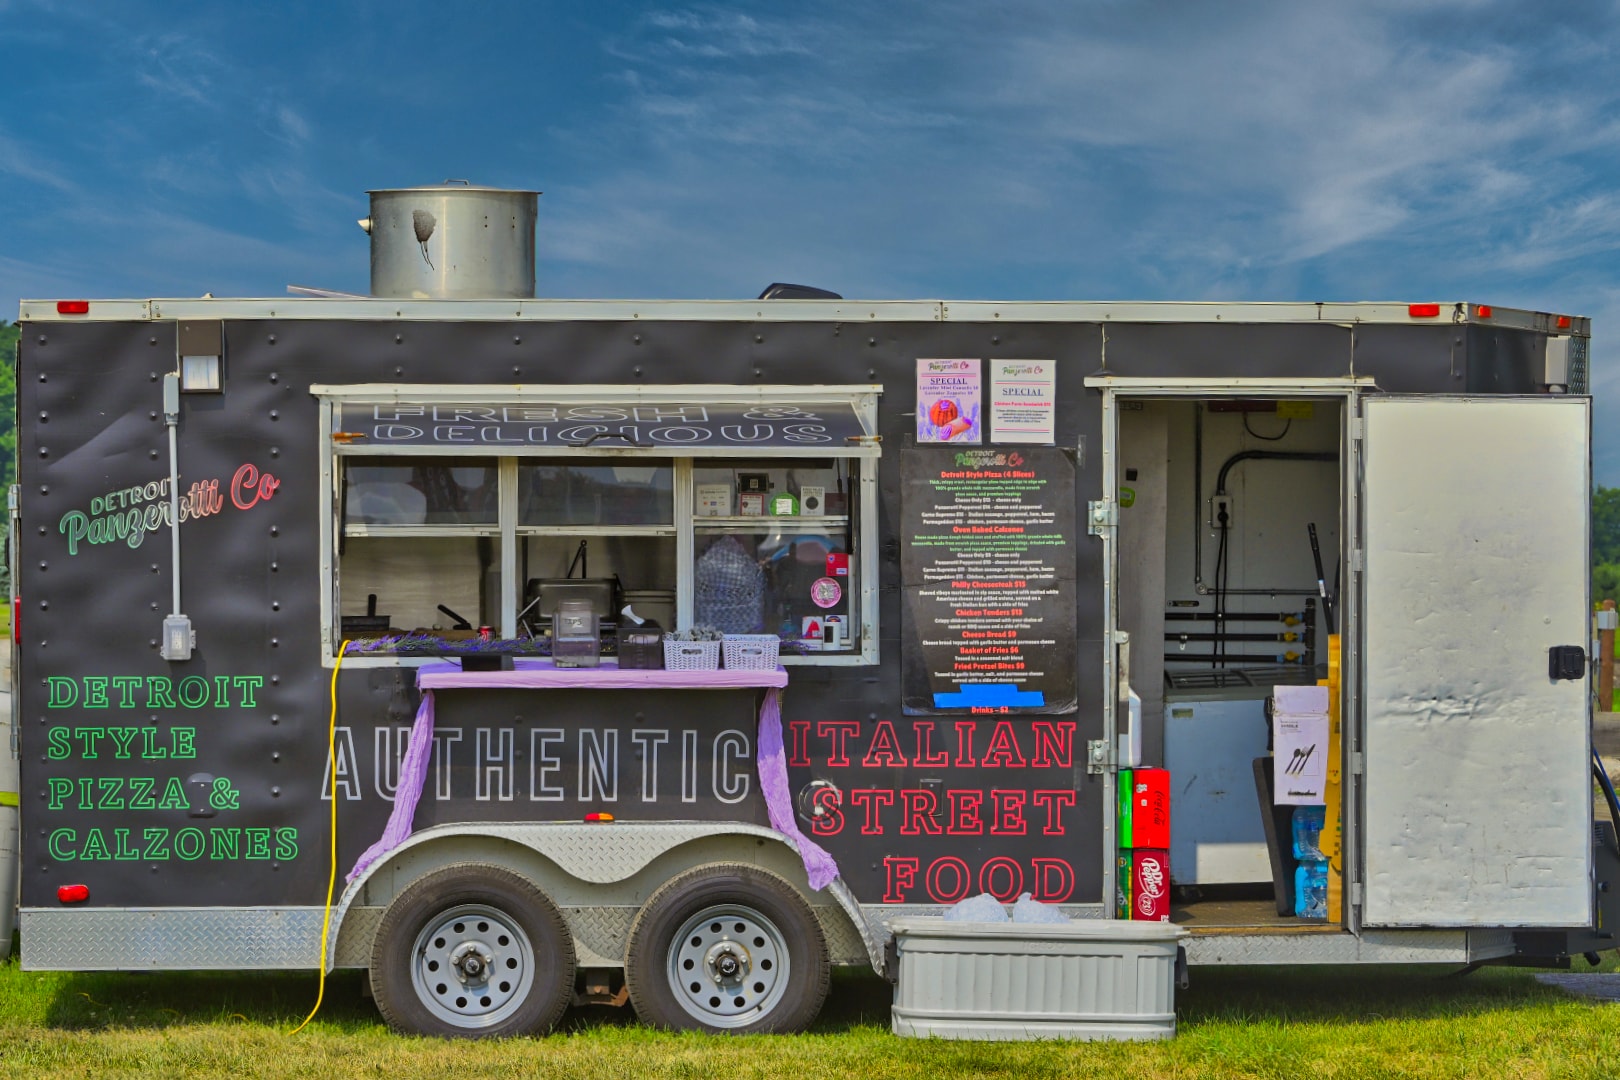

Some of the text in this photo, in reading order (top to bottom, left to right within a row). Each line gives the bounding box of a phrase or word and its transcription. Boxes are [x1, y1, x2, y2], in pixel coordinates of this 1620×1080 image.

[960, 361, 969, 372] Co
[1034, 366, 1043, 376] Co
[1002, 388, 1044, 396] SPECIAL
[374, 404, 824, 423] FRESH &
[374, 424, 832, 443] DELICIOUS
[1008, 452, 1025, 467] Co
[941, 471, 964, 479] Detroit
[965, 471, 982, 479] Style
[984, 471, 1002, 479] Pizza
[1012, 471, 1034, 479] Slices)
[231, 464, 280, 509] Co
[960, 646, 983, 654] Basket
[992, 646, 1009, 654] Fries
[1009, 646, 1019, 654] $6
[954, 662, 972, 670] Fried
[973, 662, 997, 670] Pretzel
[998, 662, 1015, 670] Bites
[48, 675, 263, 708] DETROIT
[971, 706, 994, 714] Drinks
[1000, 706, 1009, 714] $2
[48, 726, 196, 760] STYLE
[789, 721, 1076, 768] ITALIAN
[320, 726, 750, 804] AUTHENTIC
[48, 777, 240, 810] PIZZA &
[812, 787, 1076, 836] STREET
[48, 828, 299, 861] CALZONES
[883, 856, 1076, 904] FOOD
[1141, 859, 1161, 895] Pepper
[1154, 871, 1163, 886] Dr
[1142, 899, 1151, 909] 23
